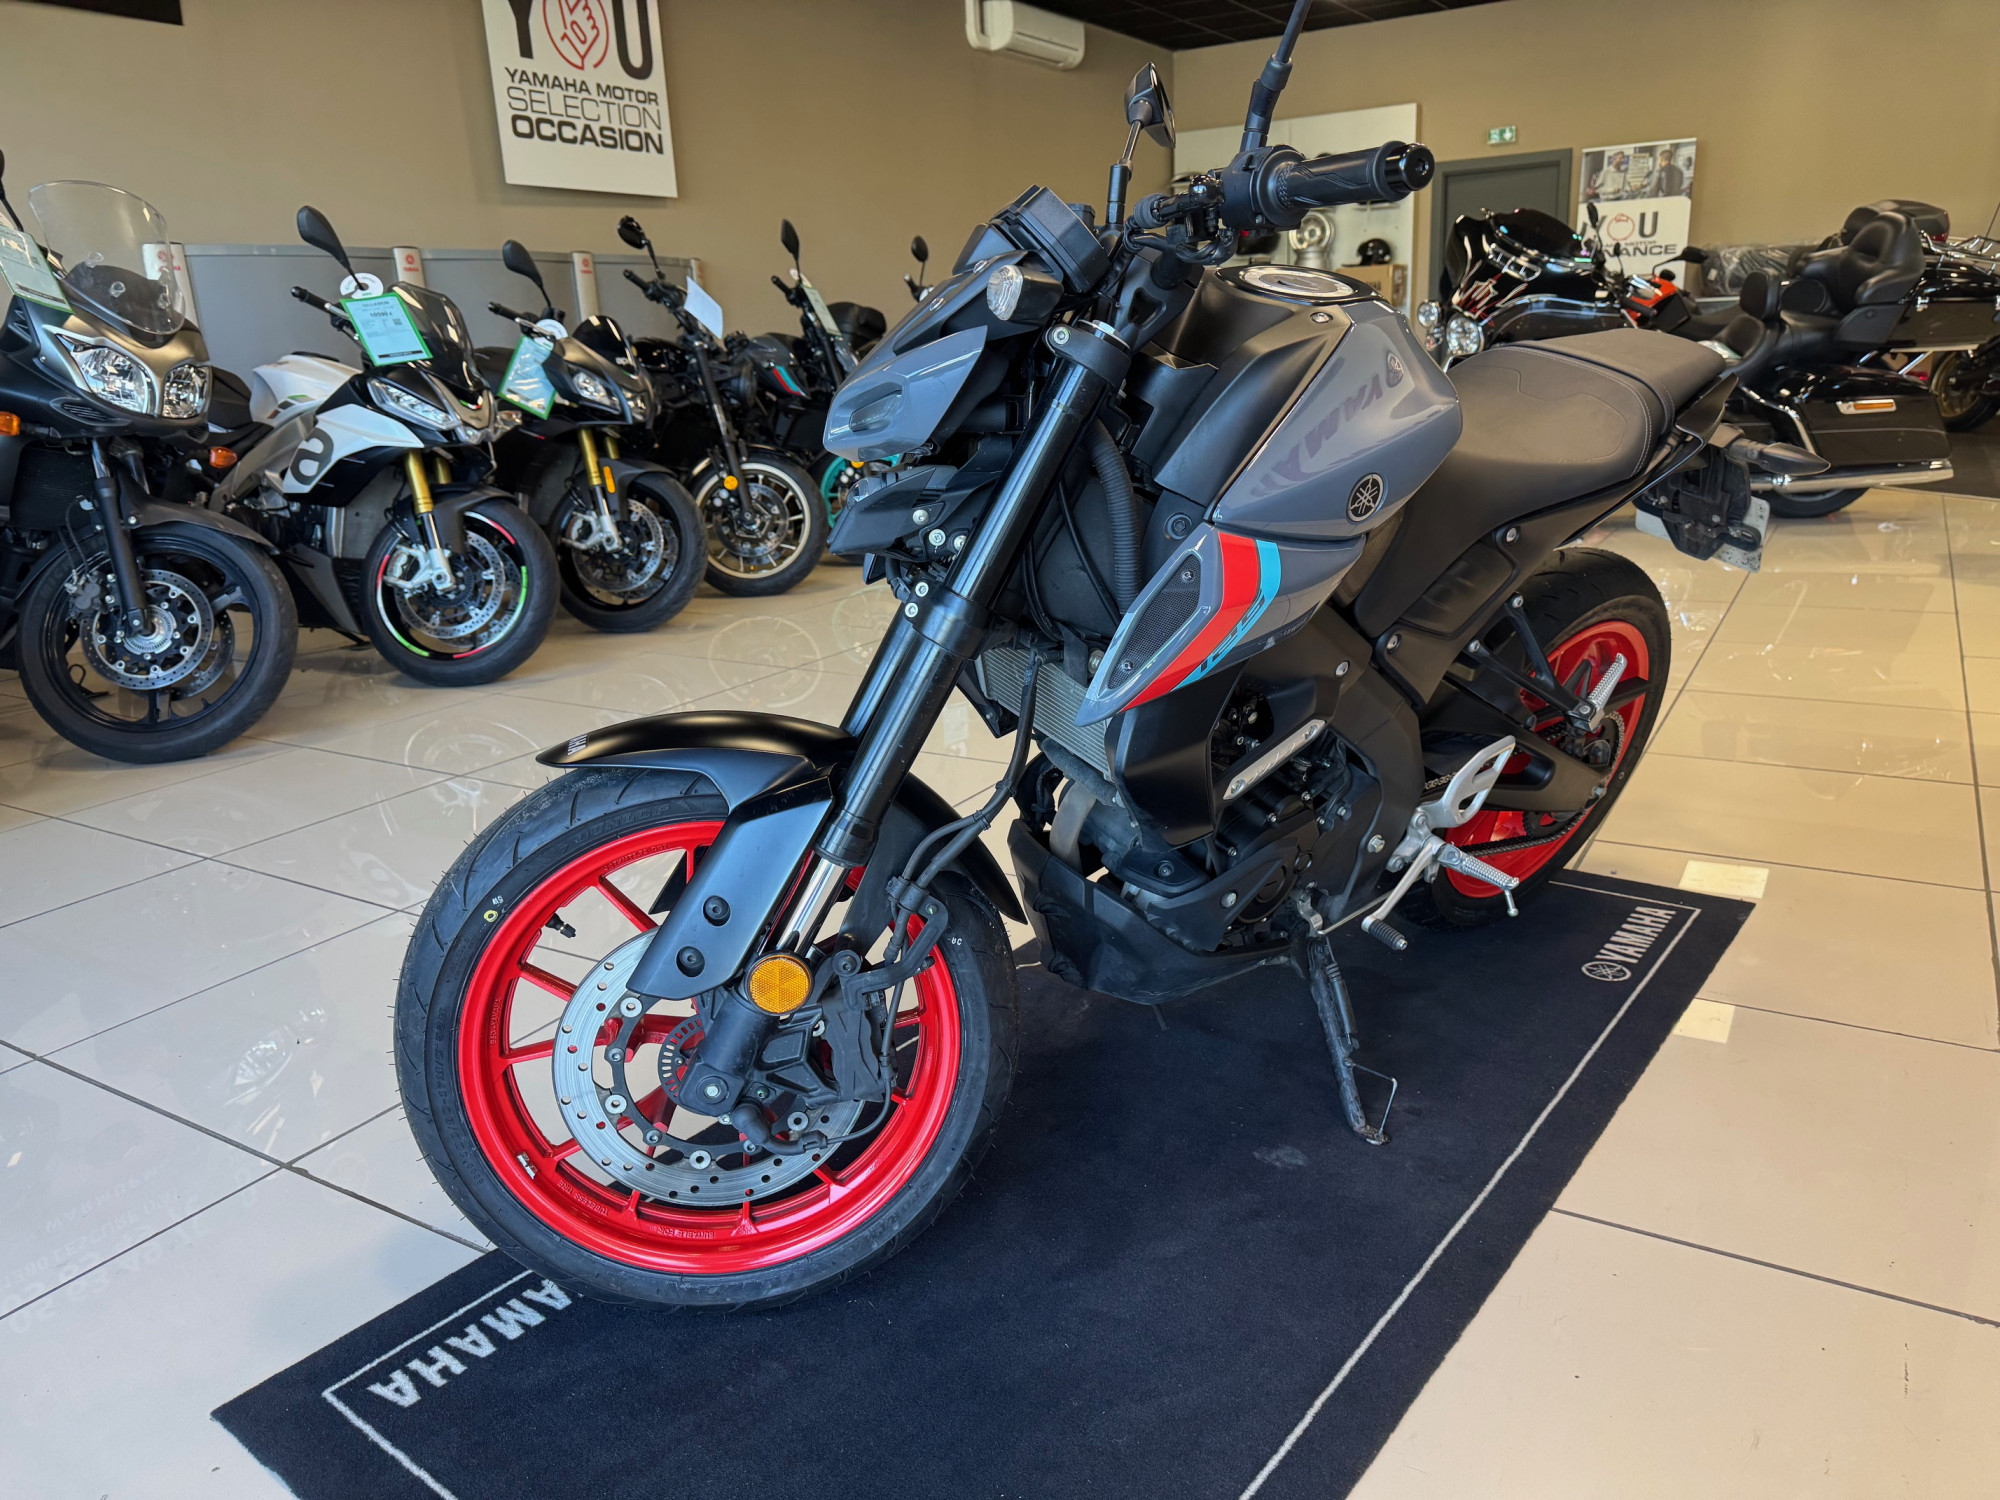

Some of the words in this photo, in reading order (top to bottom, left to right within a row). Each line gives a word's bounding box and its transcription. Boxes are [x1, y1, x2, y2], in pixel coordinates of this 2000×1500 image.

[504, 66, 591, 96] YAMAHA
[597, 82, 659, 106] MOTOR
[506, 86, 662, 131] SELECTION
[511, 113, 664, 155] OCCASION
[1200, 590, 1266, 673] 125
[1595, 905, 1678, 964] YAMAHA
[365, 1278, 573, 1409] AMAHA
